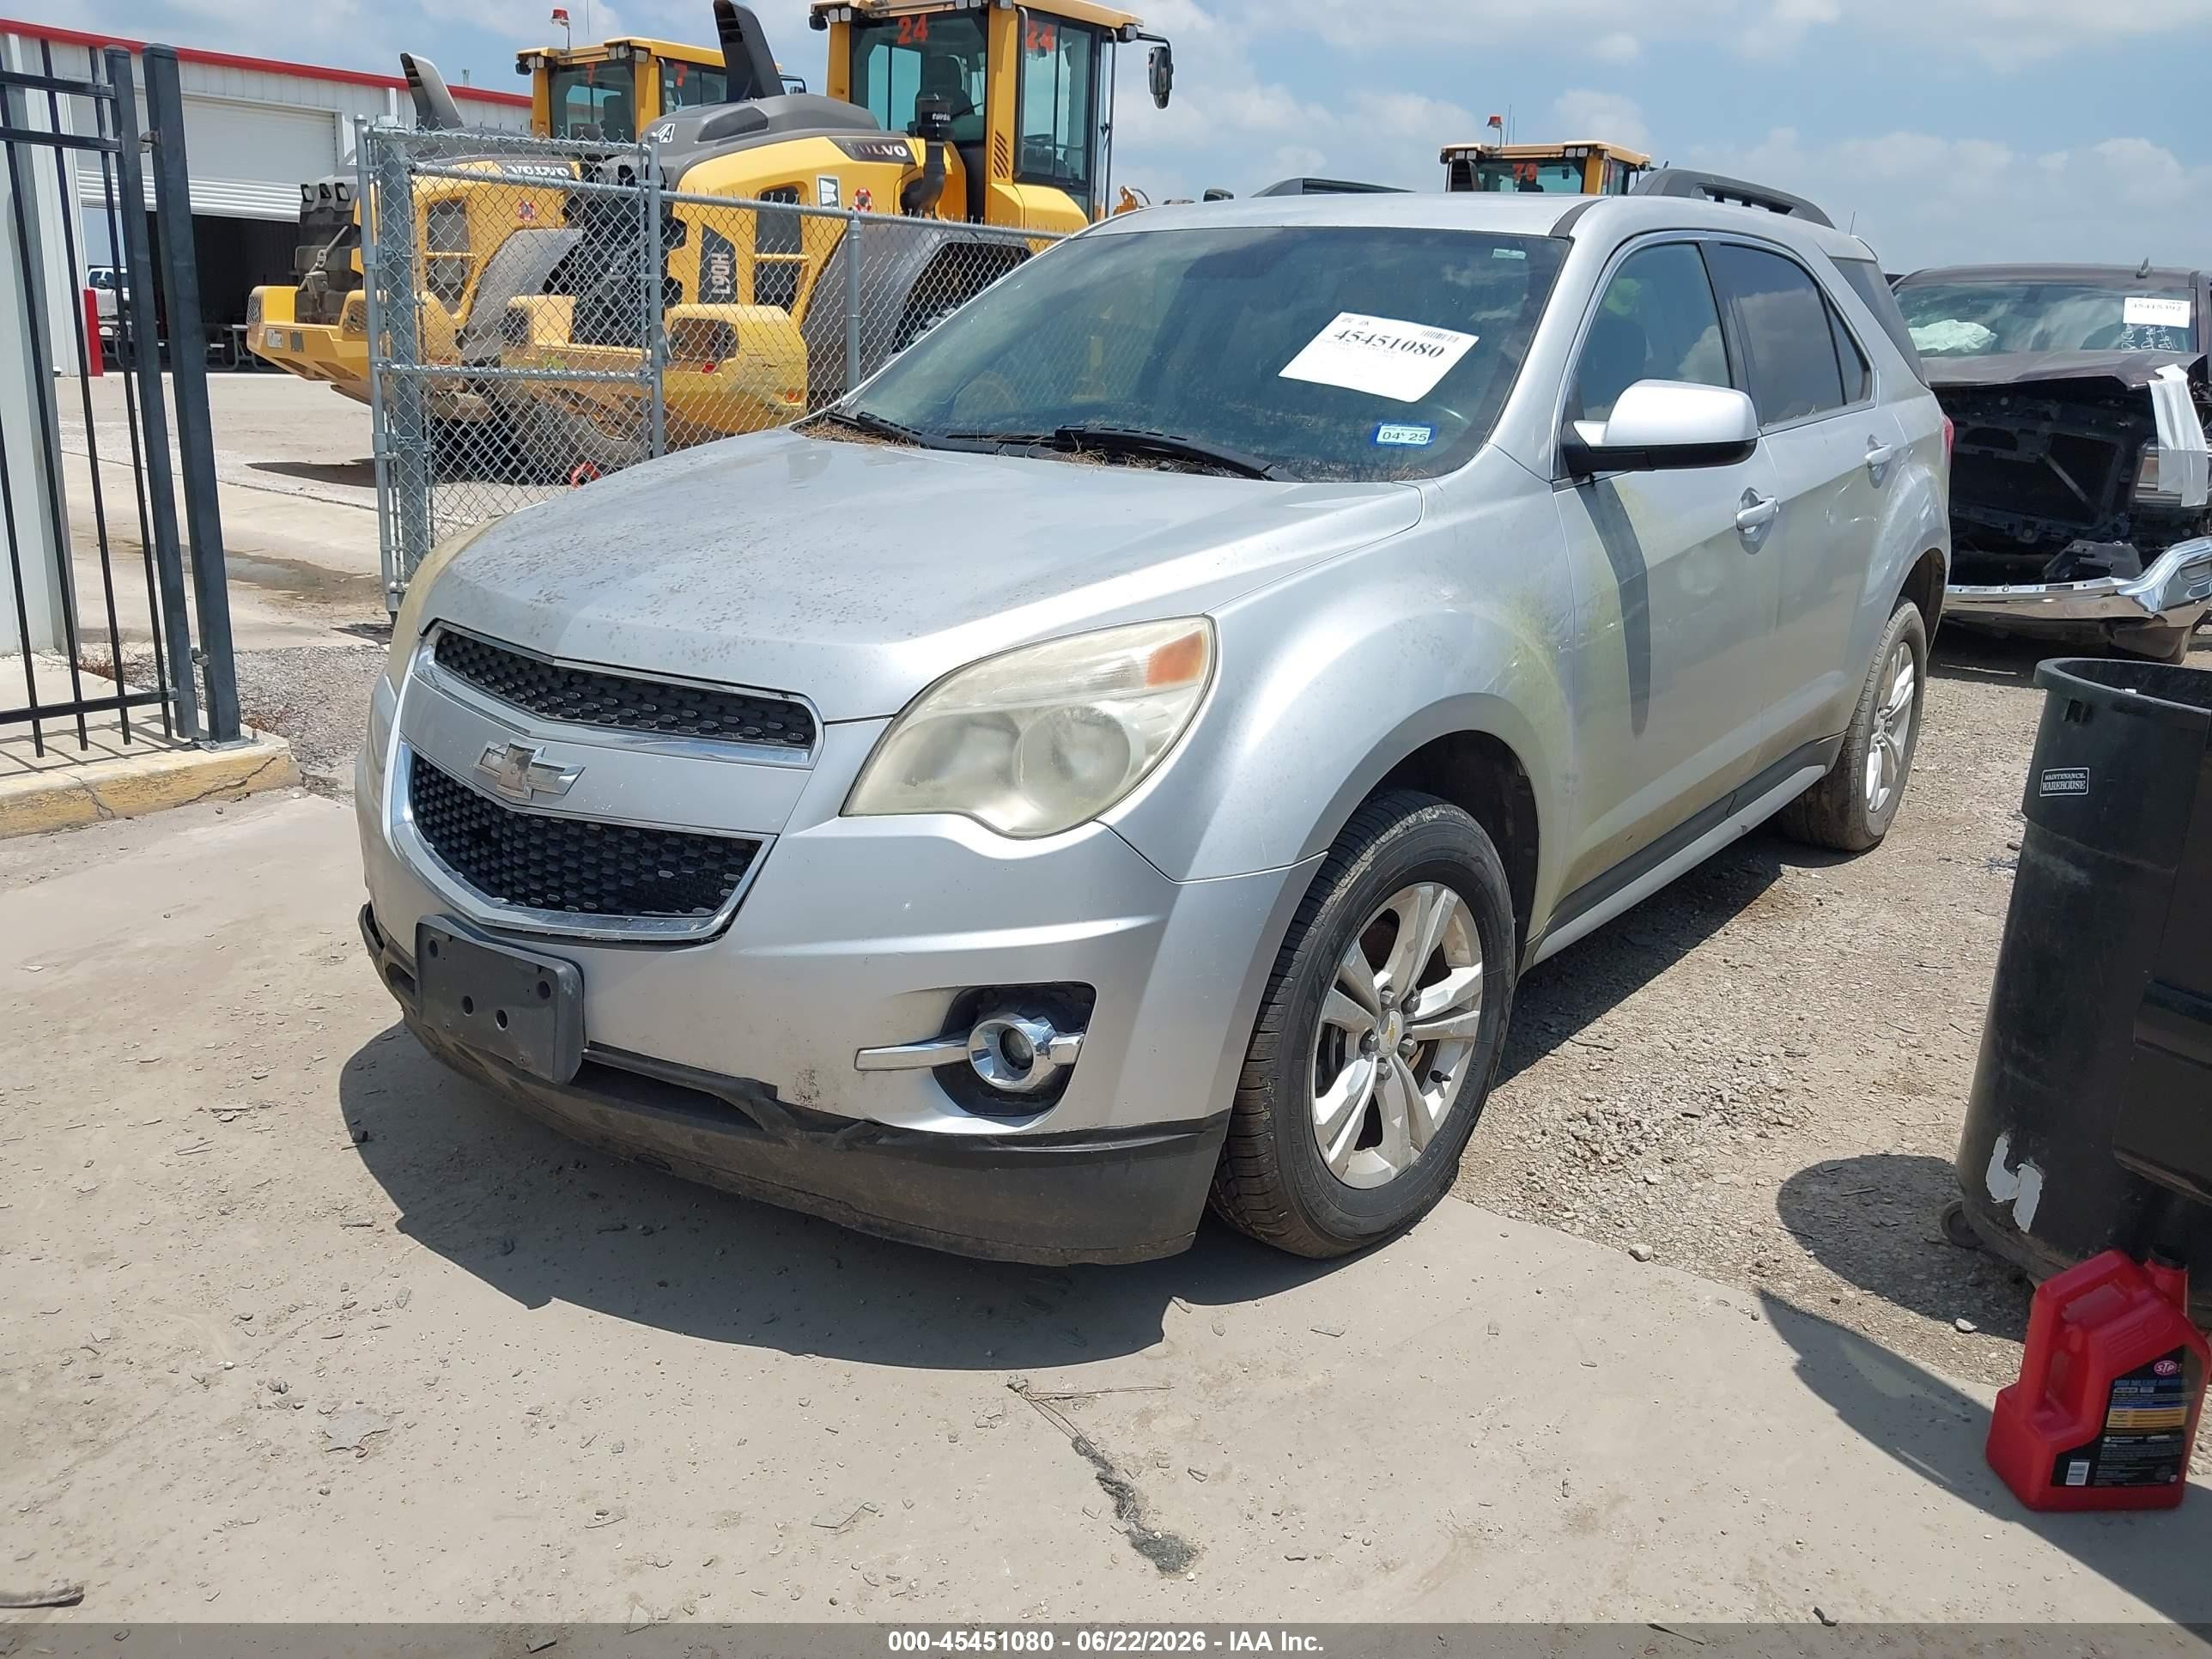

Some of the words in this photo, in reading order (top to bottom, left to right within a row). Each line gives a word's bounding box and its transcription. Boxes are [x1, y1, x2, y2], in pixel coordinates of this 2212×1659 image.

[896, 15, 928, 45] 24
[1027, 20, 1054, 51] 24
[586, 63, 595, 84] 7
[673, 64, 687, 87] 7
[506, 165, 570, 177] VOLVO
[711, 252, 730, 294] L90H
[1334, 330, 1445, 358] 45451080
[1408, 433, 1427, 441] 25
[2043, 781, 2086, 791] WAREHOUSE
[2156, 1362, 2175, 1373] STP
